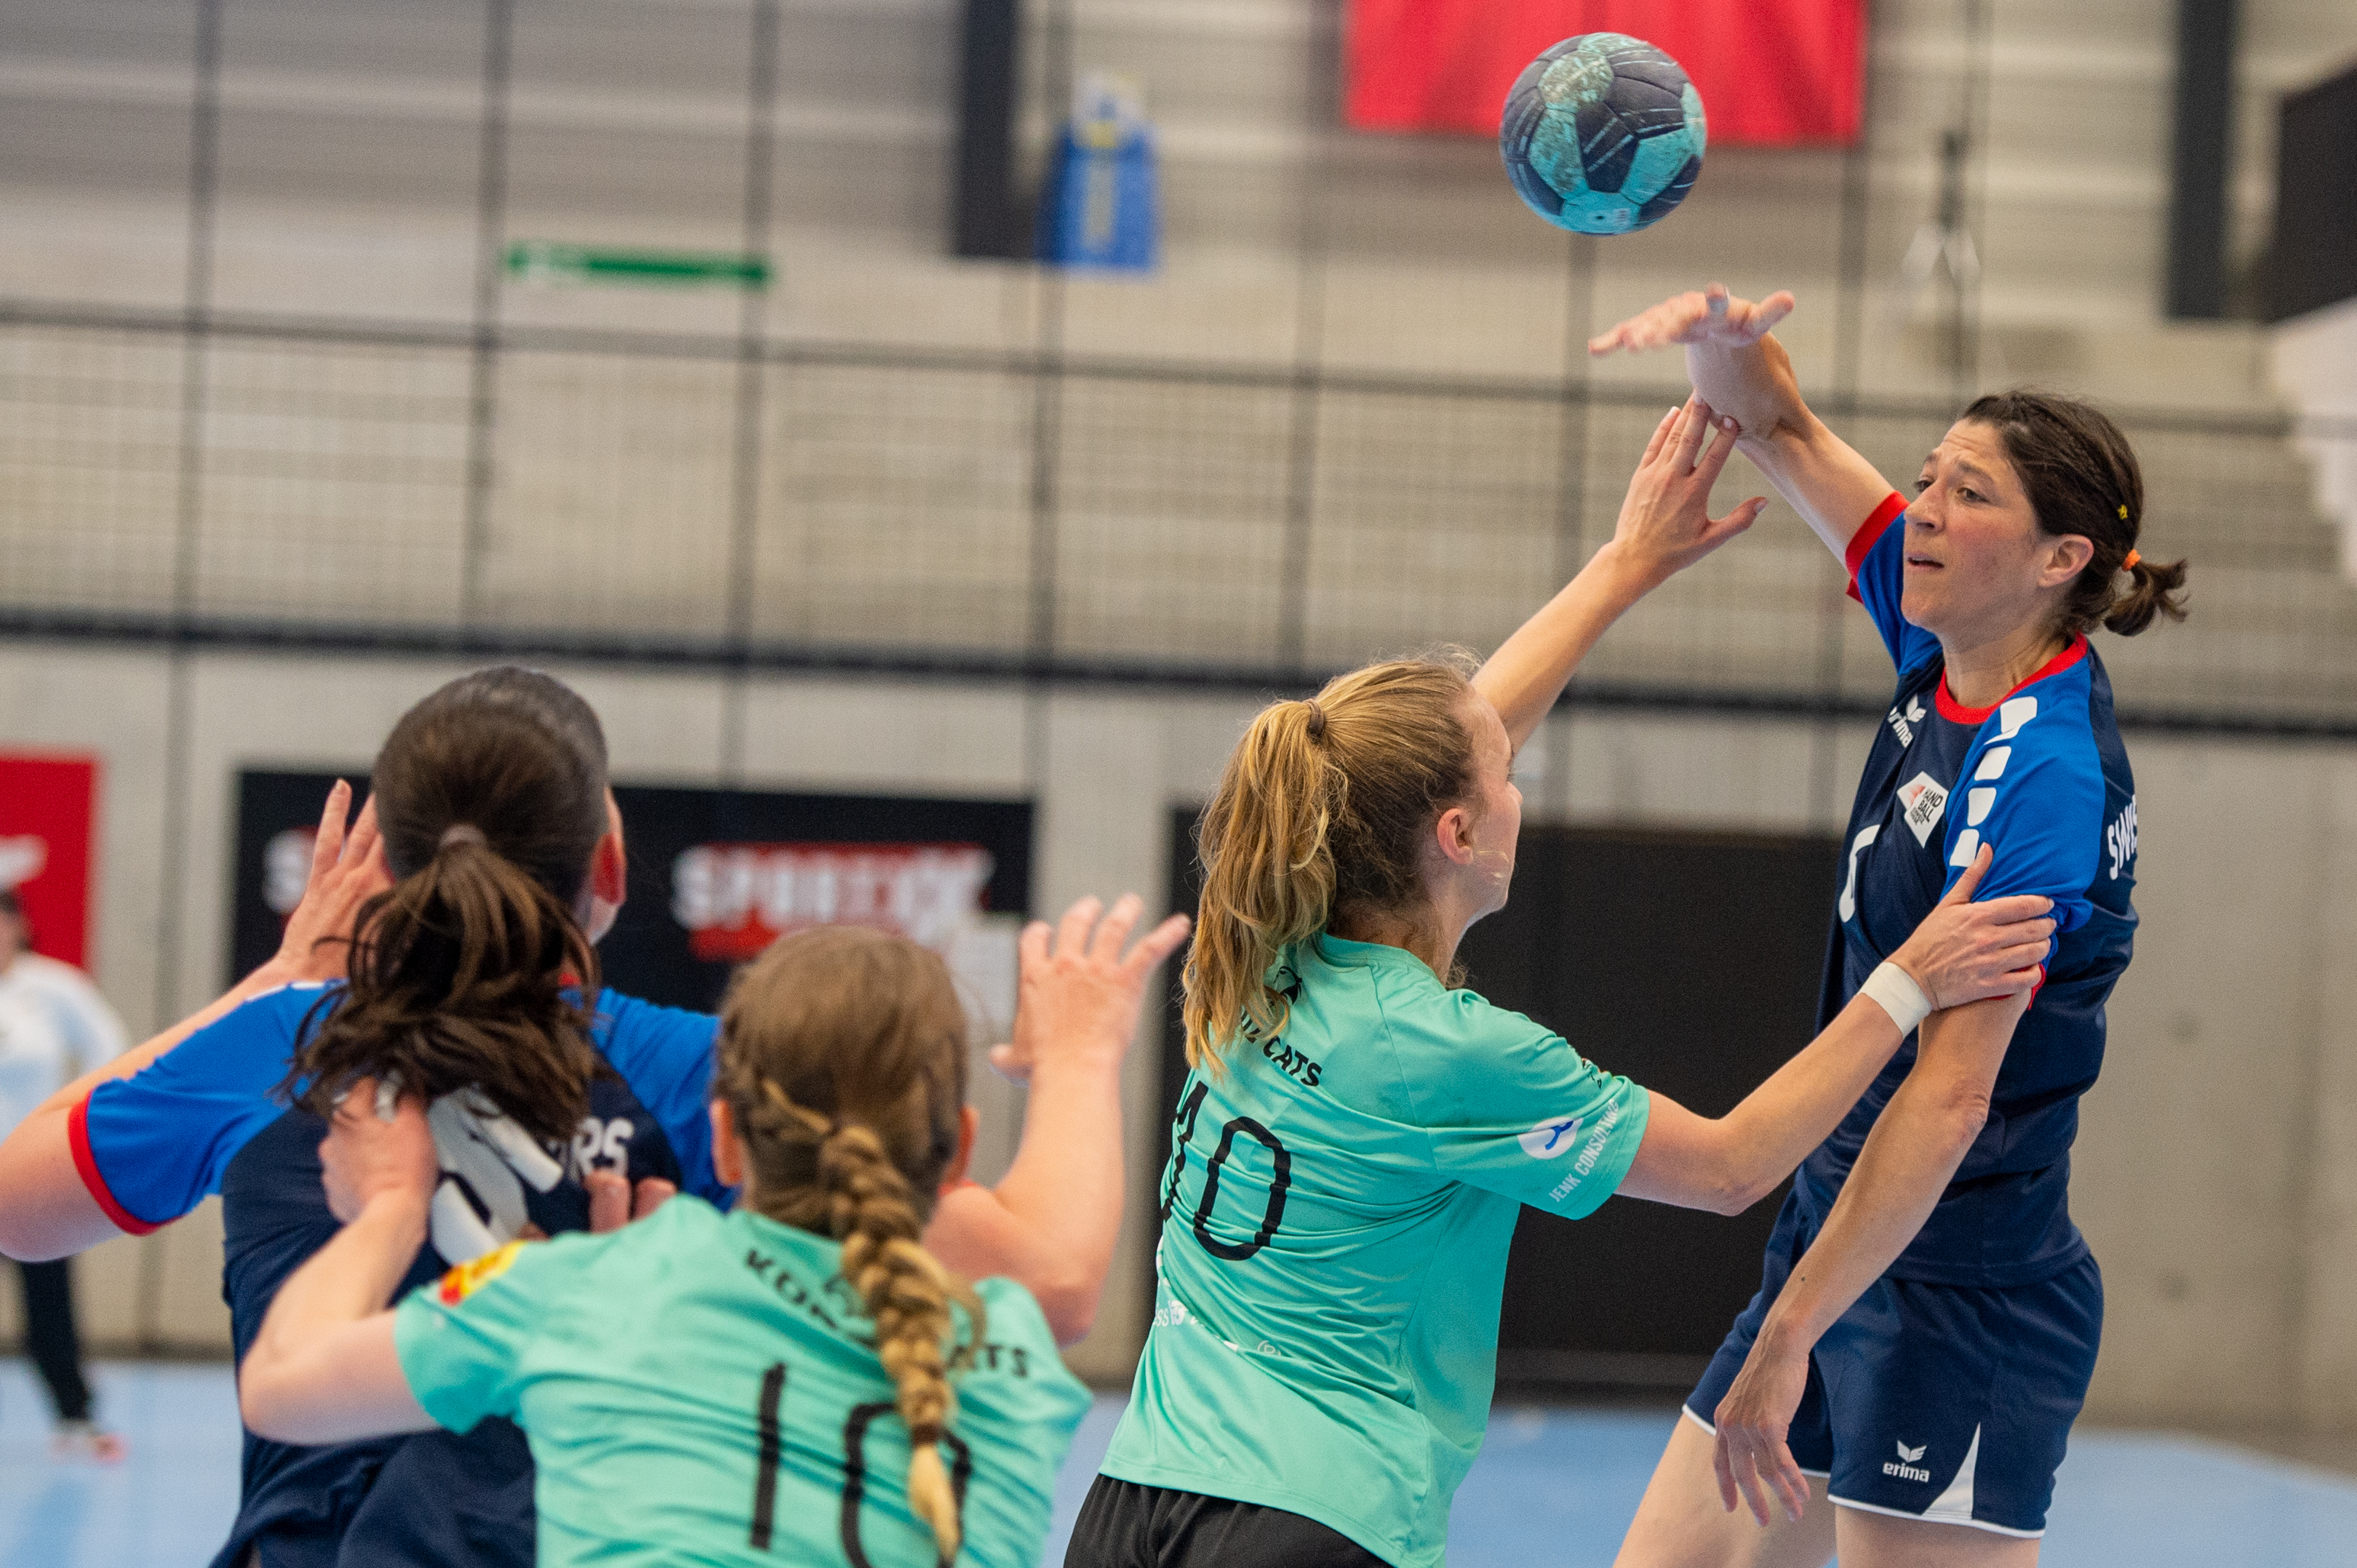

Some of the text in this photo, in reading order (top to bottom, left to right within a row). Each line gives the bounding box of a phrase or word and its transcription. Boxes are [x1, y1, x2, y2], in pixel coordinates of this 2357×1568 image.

[1918, 800, 1934, 823] BALL
[1923, 788, 1944, 808] HAND
[1263, 1036, 1323, 1087] CATS
[1549, 1098, 1619, 1202] JENK CONSULTING
[1162, 1080, 1292, 1261] 10
[1882, 1461, 1931, 1482] erima
